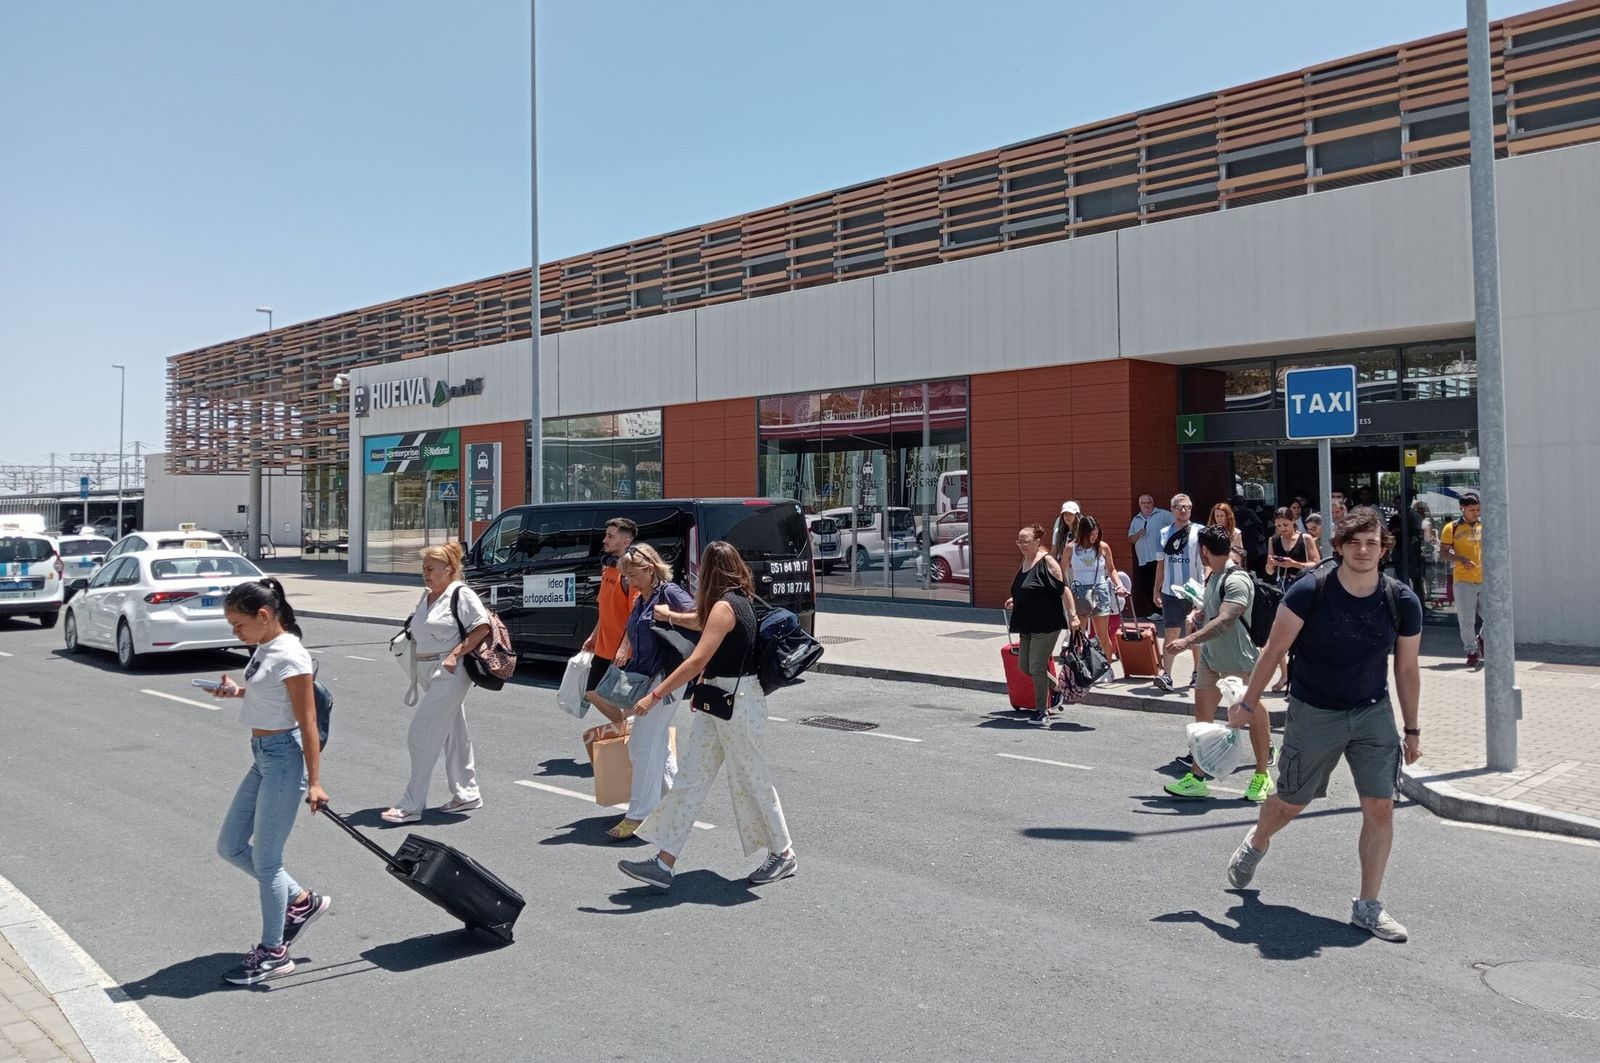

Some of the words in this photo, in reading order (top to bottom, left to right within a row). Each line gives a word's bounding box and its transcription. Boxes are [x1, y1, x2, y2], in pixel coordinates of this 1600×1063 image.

[370, 377, 429, 410] HUELVA
[876, 403, 888, 417] de
[891, 401, 926, 415] Huelva
[1290, 391, 1352, 415] TAXI
[386, 446, 420, 458] enterprise
[919, 477, 955, 488] CRISAL
[770, 562, 782, 574] 651
[784, 562, 792, 572] 84
[793, 561, 800, 572] 10
[802, 560, 808, 571] 17
[548, 578, 564, 588] ideo
[772, 583, 786, 594] 678
[787, 582, 795, 594] 18
[795, 582, 803, 593] 77
[804, 582, 810, 592] 14
